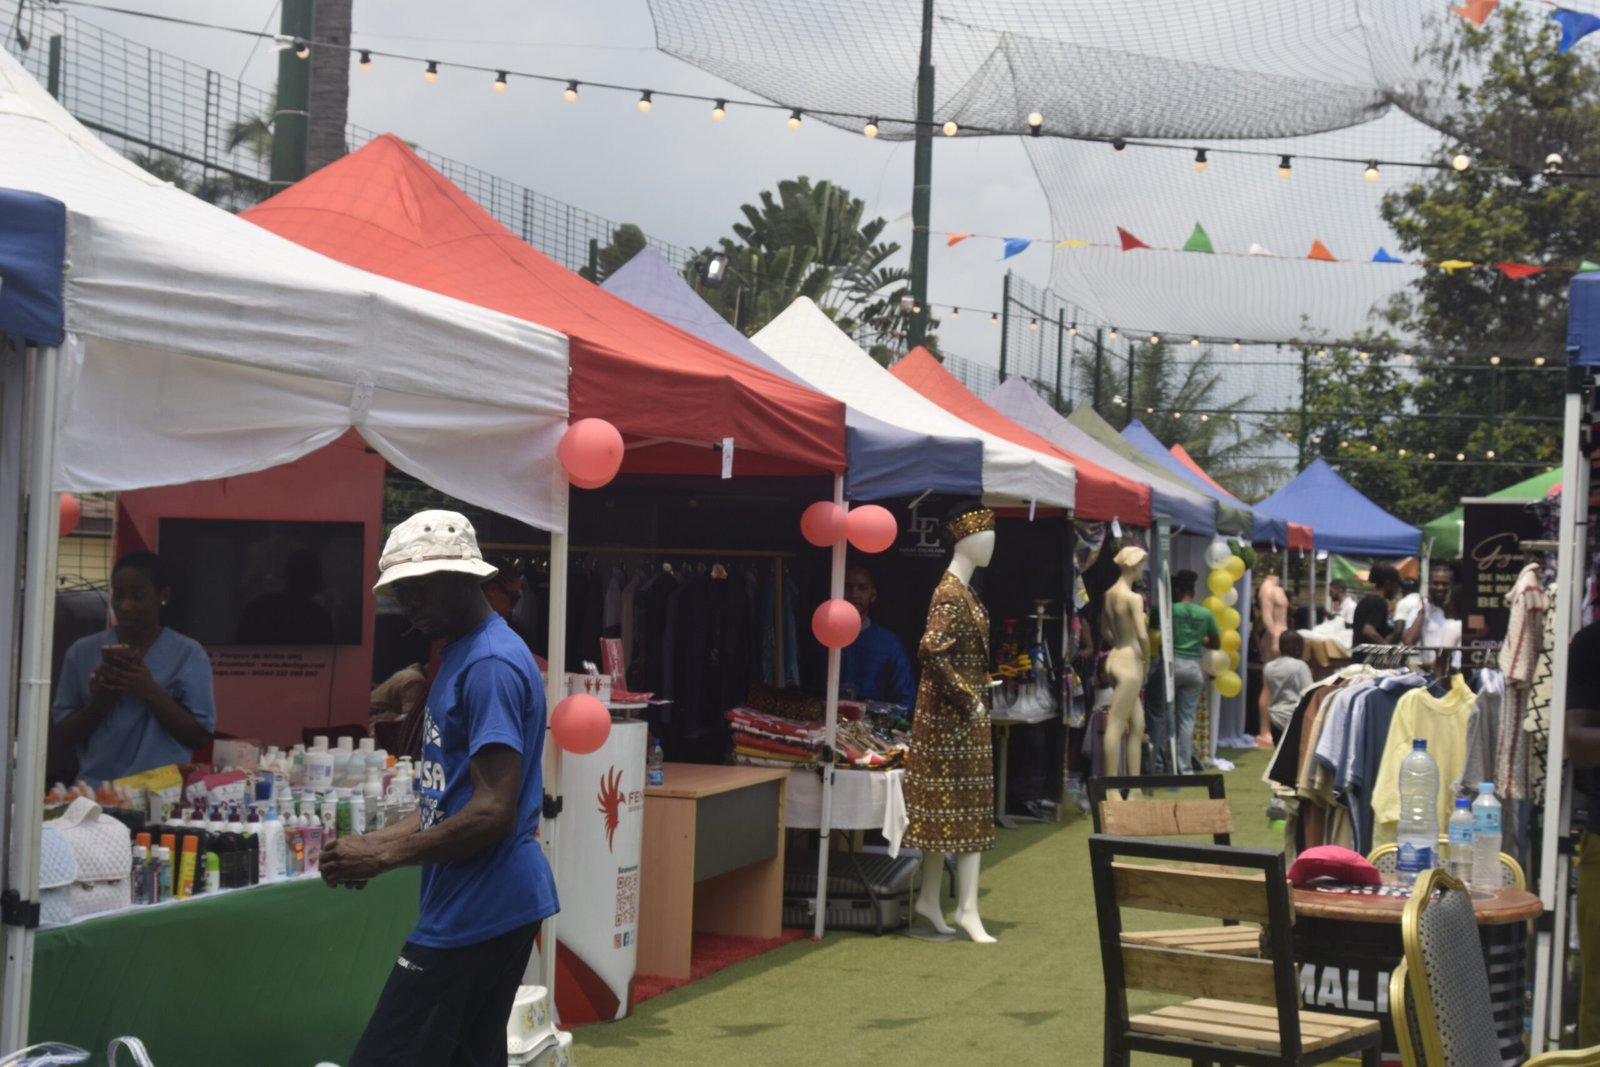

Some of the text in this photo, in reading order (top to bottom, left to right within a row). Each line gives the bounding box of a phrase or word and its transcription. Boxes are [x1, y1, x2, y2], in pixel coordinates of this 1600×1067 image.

[1478, 573, 1493, 582] BE
[1478, 584, 1493, 593] BE
[1477, 597, 1499, 608] BE
